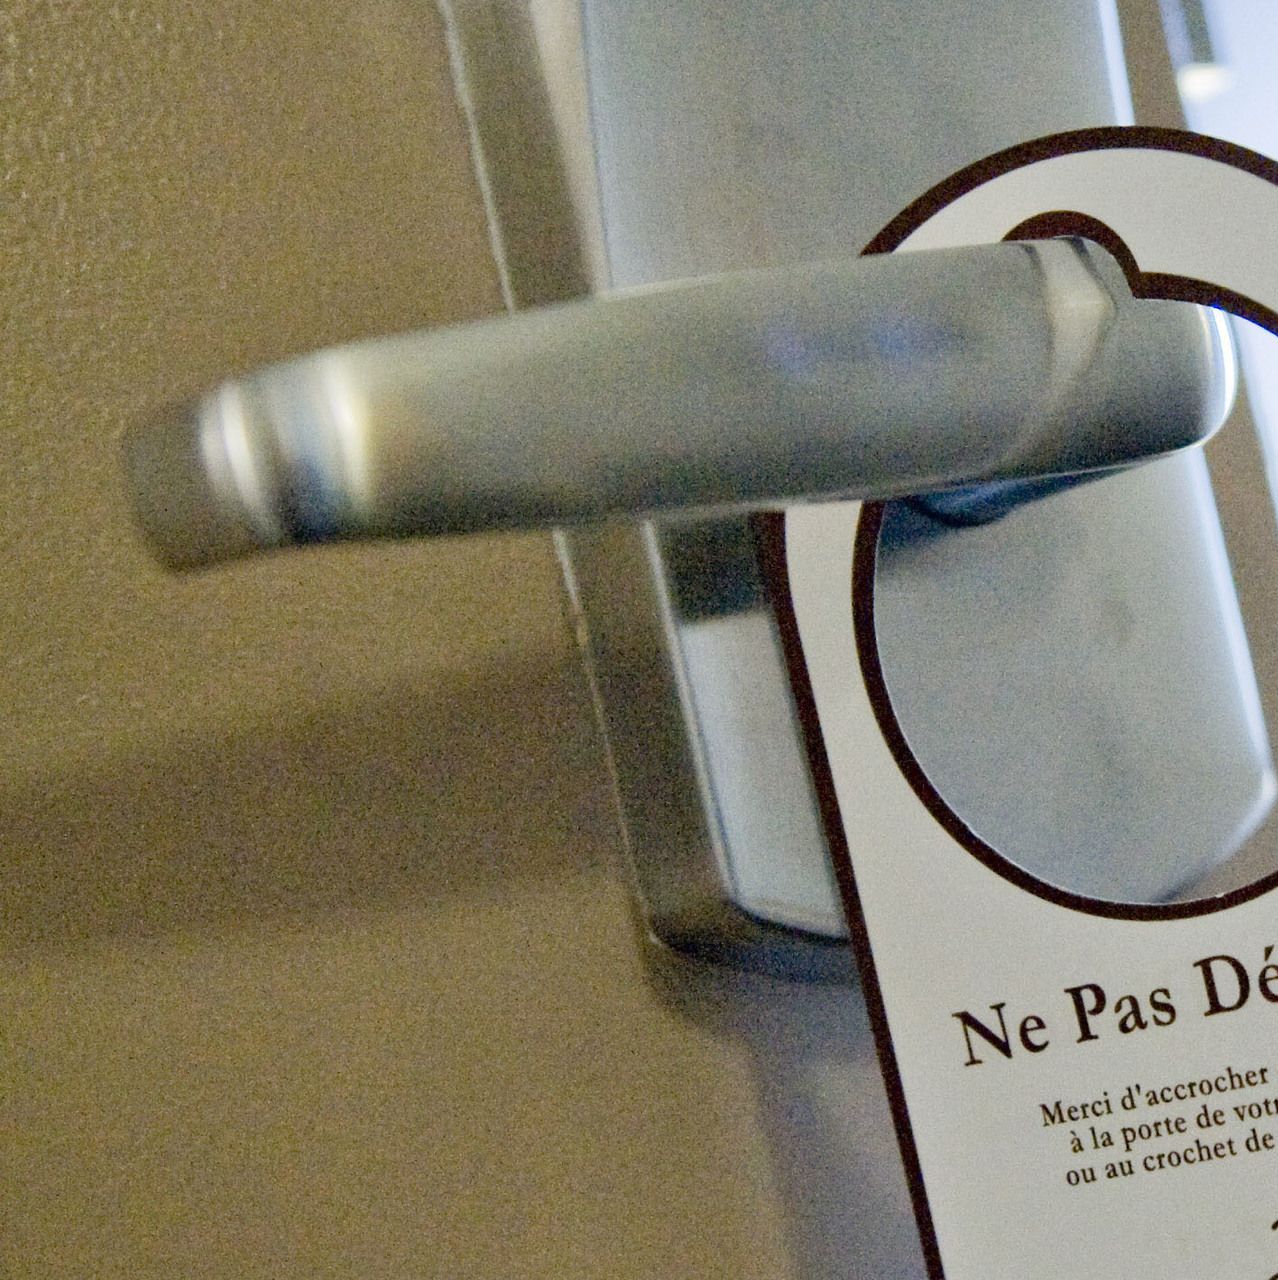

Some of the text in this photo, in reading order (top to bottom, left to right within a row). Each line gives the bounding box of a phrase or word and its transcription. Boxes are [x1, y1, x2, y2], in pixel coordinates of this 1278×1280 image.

[952, 1002, 1049, 1066] Ne
[1064, 982, 1177, 1044] Pas
[1039, 1091, 1113, 1127] Merci
[1121, 1067, 1268, 1112] d'accrocher
[1066, 1169, 1097, 1186] ou
[1105, 1159, 1135, 1180] au
[1143, 1138, 1237, 1172] crochet
[1245, 1128, 1275, 1153] de
[1070, 1130, 1084, 1154] à
[1090, 1126, 1114, 1150] la
[1121, 1116, 1188, 1152] porte
[1196, 1104, 1226, 1129] de
